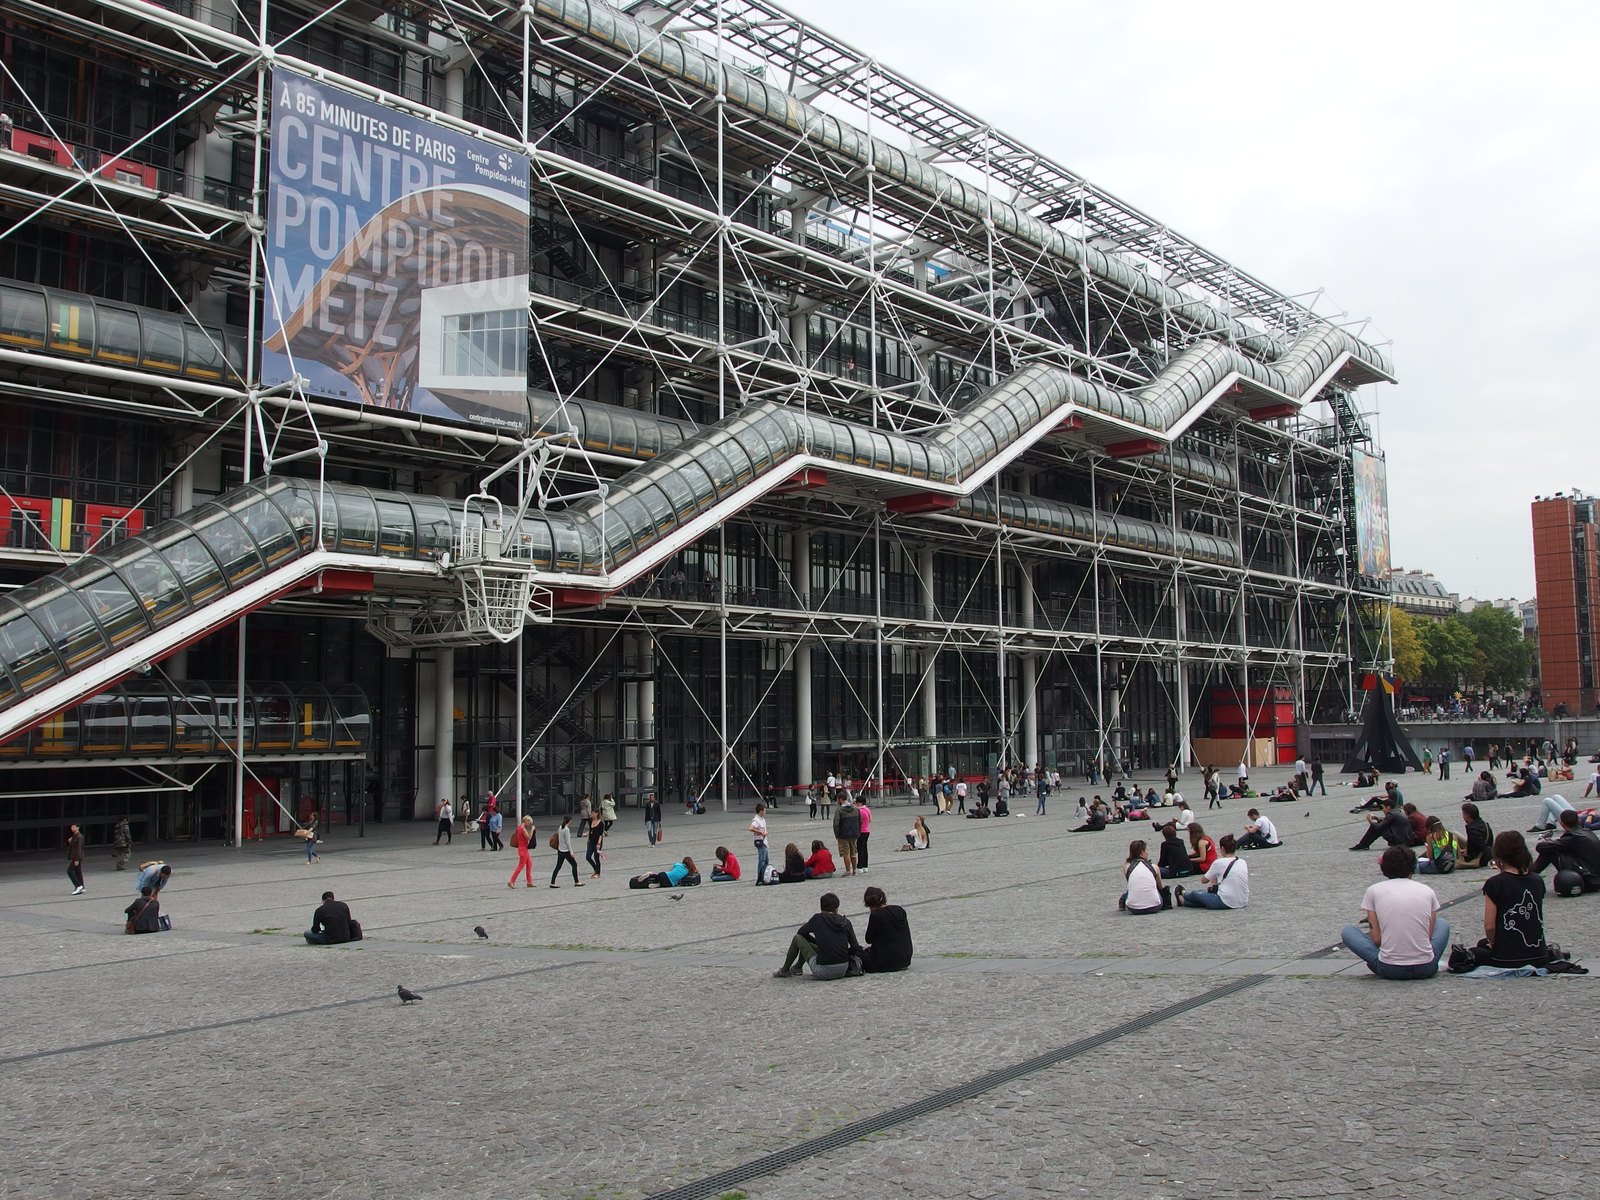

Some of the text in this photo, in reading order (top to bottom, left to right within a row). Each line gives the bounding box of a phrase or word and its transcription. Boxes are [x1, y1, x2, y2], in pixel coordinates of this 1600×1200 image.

[280, 82, 456, 165] À 85 MINUTES DE PARIS
[466, 149, 490, 166] Centre
[278, 115, 456, 228] CENTRE
[475, 163, 527, 189] Pompidou-Metz
[272, 256, 399, 347] METZ
